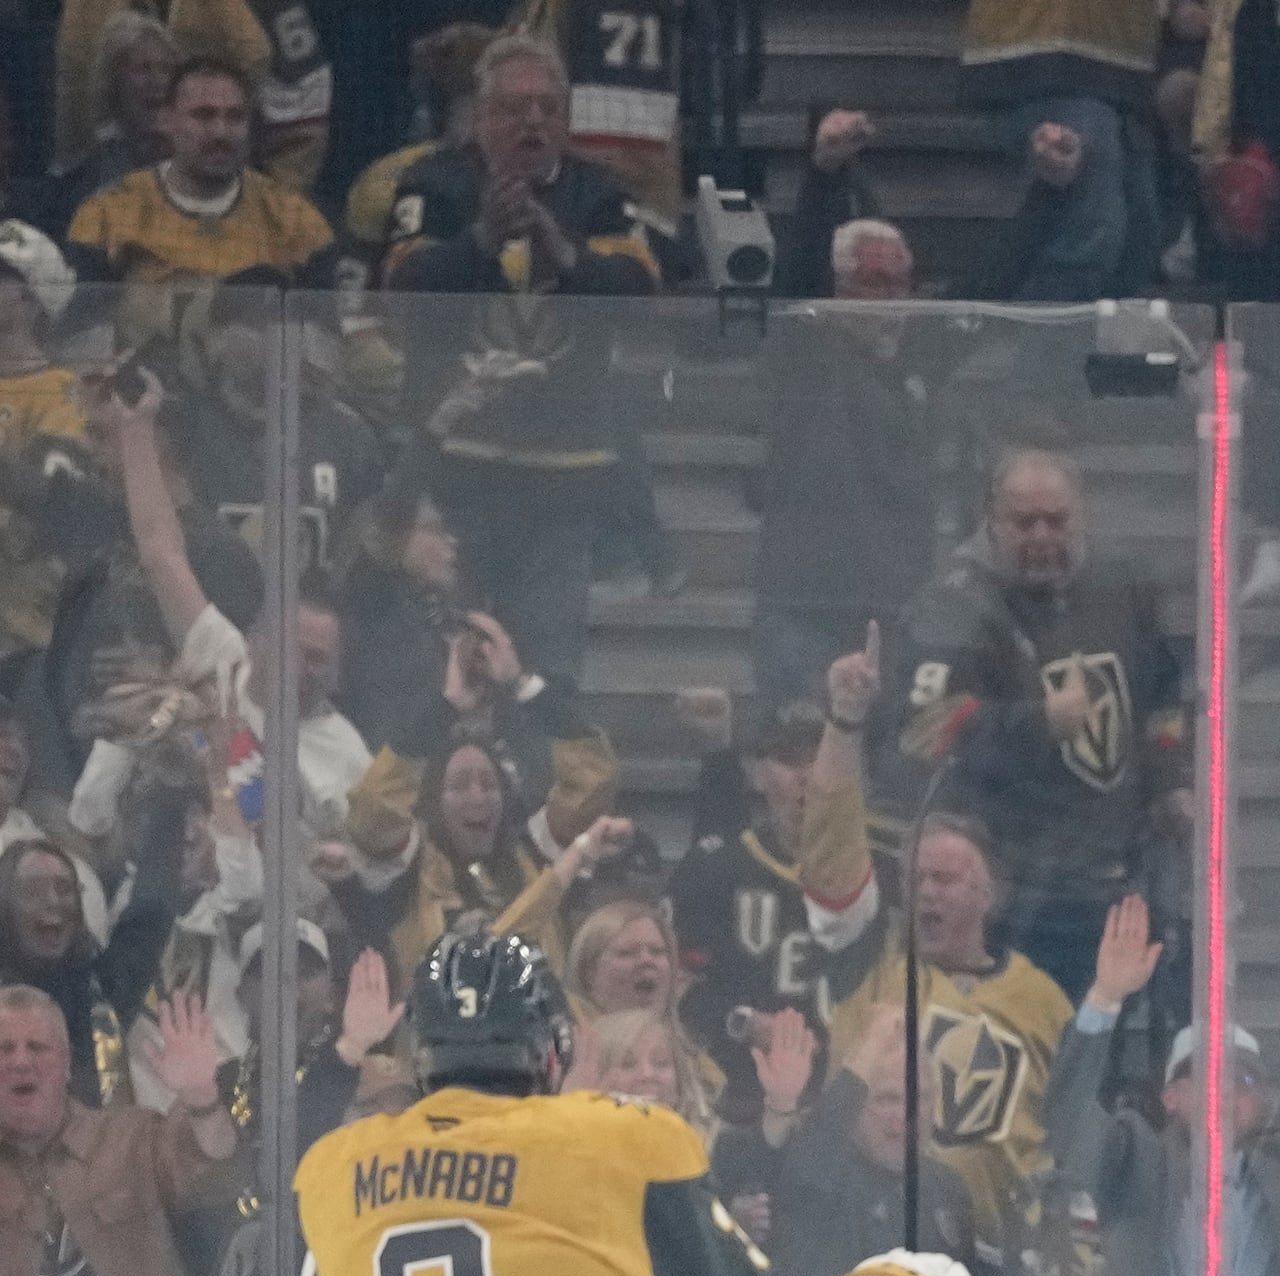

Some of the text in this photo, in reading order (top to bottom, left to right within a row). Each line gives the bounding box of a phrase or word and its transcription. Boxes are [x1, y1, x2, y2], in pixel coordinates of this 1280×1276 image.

[600, 12, 664, 69] 71
[456, 986, 478, 1019] 3
[354, 1147, 518, 1217] McNABB
